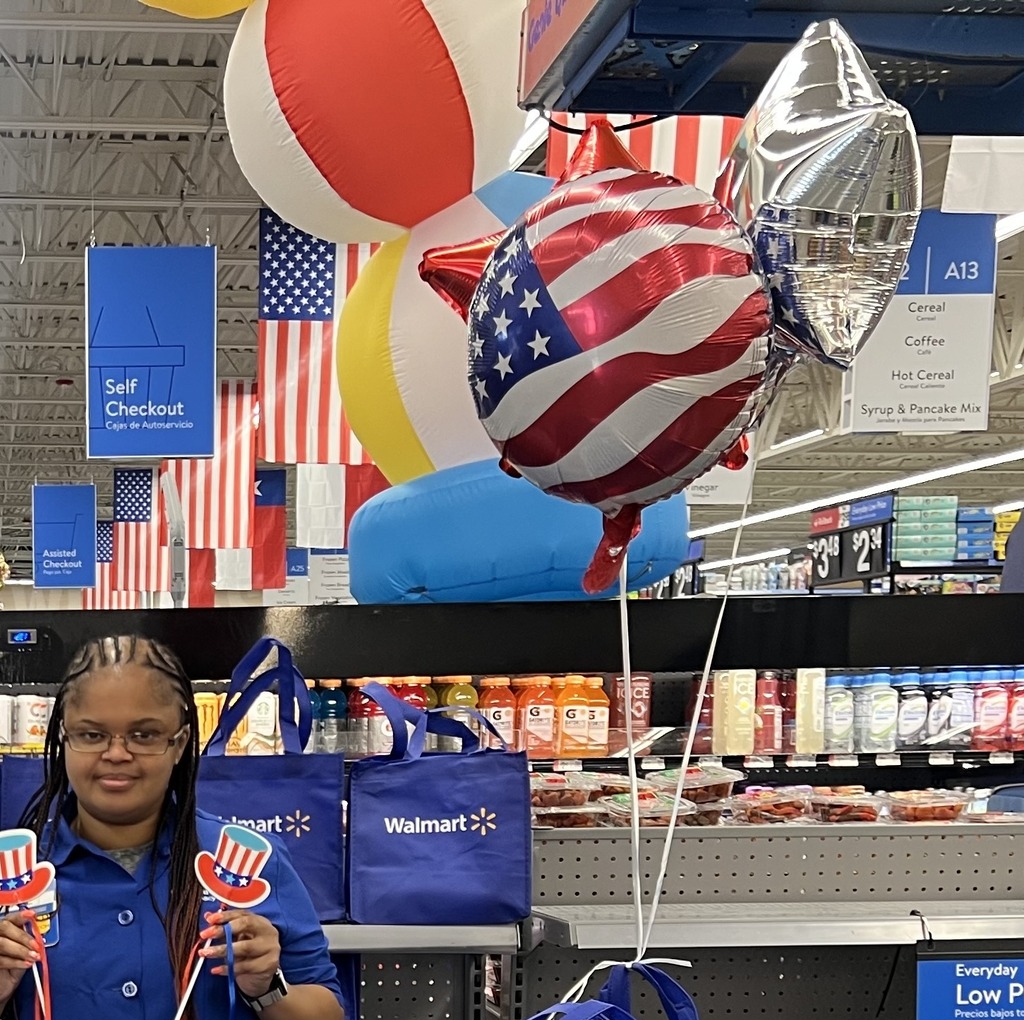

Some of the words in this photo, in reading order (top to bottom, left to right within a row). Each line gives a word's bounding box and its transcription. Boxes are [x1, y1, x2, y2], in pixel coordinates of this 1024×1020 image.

[944, 261, 979, 280] A13
[908, 302, 946, 313] Cereal
[905, 336, 945, 347] Coffee
[891, 370, 914, 380] Hot
[917, 369, 955, 380] Cereal
[106, 378, 138, 394] Self
[106, 400, 184, 416] Checkout
[861, 404, 894, 417] Syrup
[897, 404, 906, 414] &
[909, 403, 957, 414] Pancake
[960, 402, 982, 413] Mix
[106, 421, 127, 431] Cajas
[129, 420, 140, 429] de
[142, 420, 193, 429] Autoservicio
[42, 549, 77, 558] Assisted
[43, 560, 82, 569] Checkout
[290, 565, 305, 573] A25
[384, 814, 467, 834] Walmart
[955, 963, 1018, 979] Everyday
[956, 984, 1002, 1005] Low
[955, 1008, 989, 1018] Precios
[990, 1008, 1015, 1020] bajos
